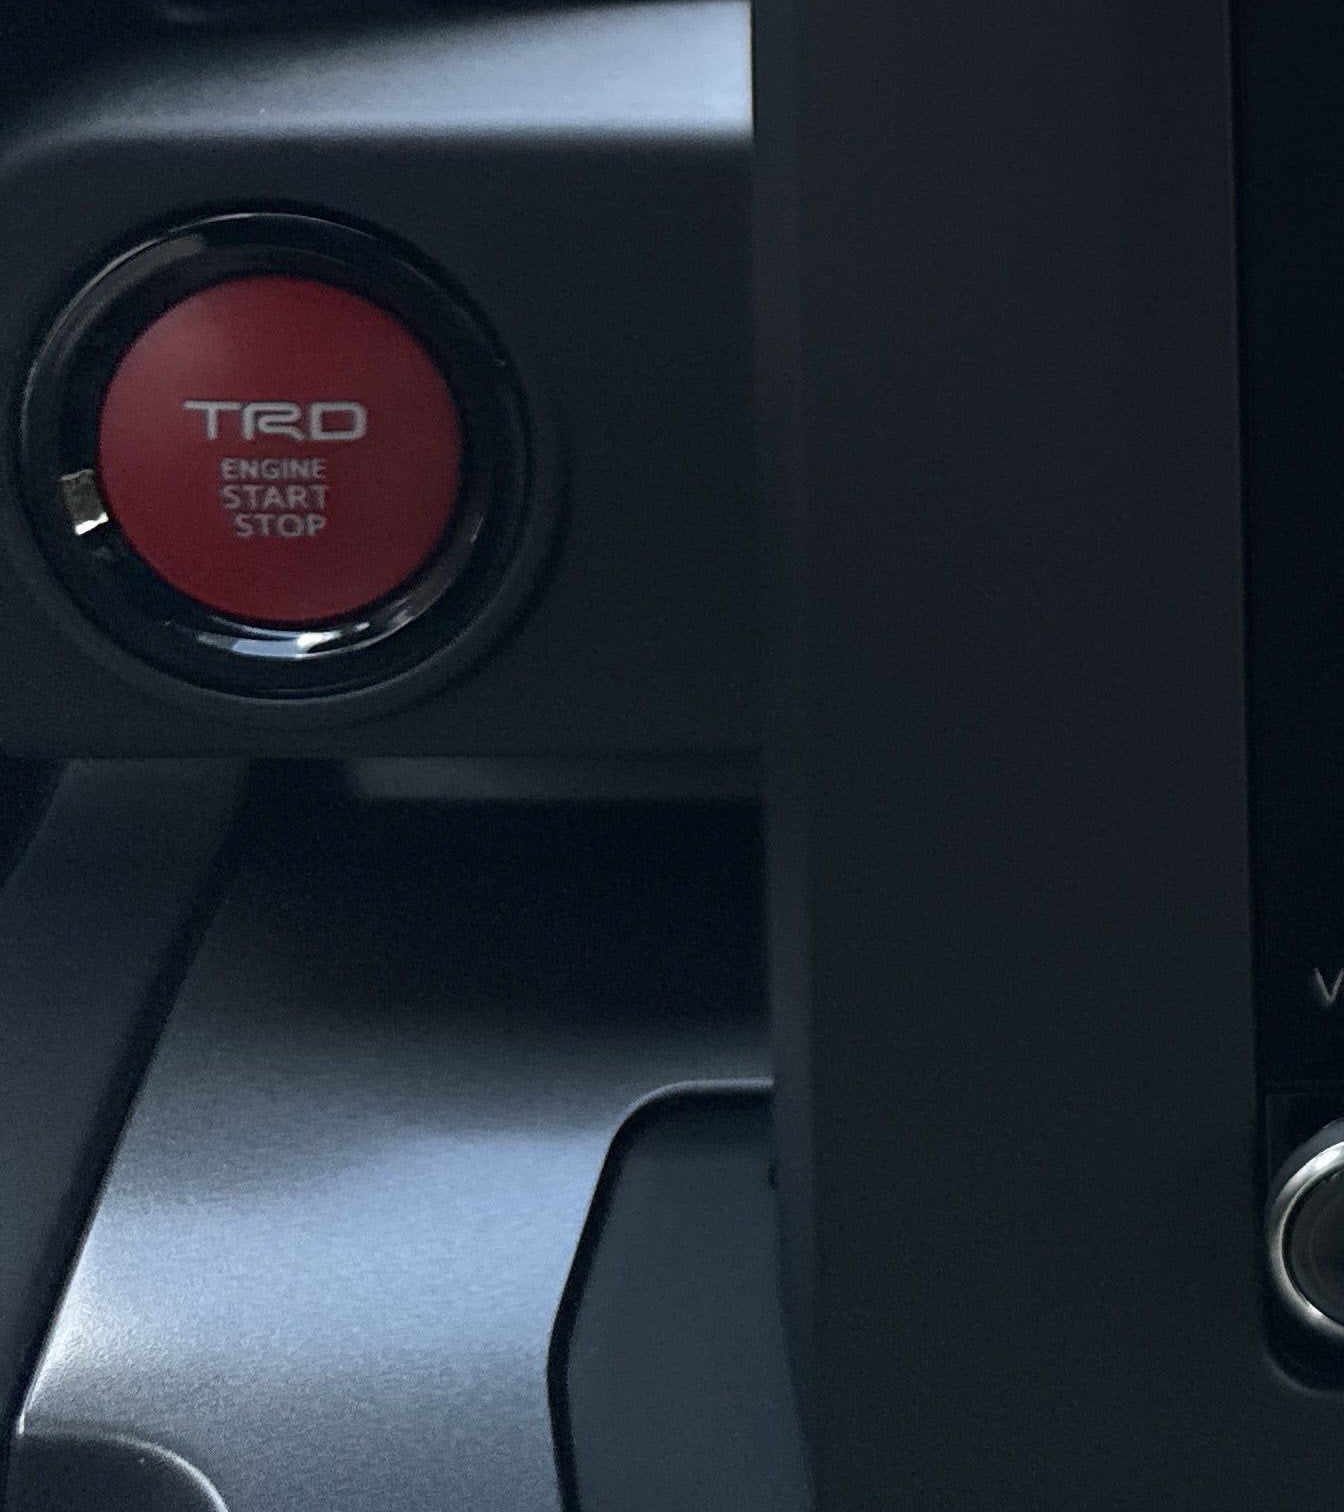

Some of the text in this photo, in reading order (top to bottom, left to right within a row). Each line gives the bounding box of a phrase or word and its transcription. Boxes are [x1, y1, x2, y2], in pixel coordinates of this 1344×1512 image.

[182, 400, 365, 440] TRD
[220, 458, 324, 480] ENGINE
[218, 484, 327, 509] START
[234, 514, 326, 538] STOP
